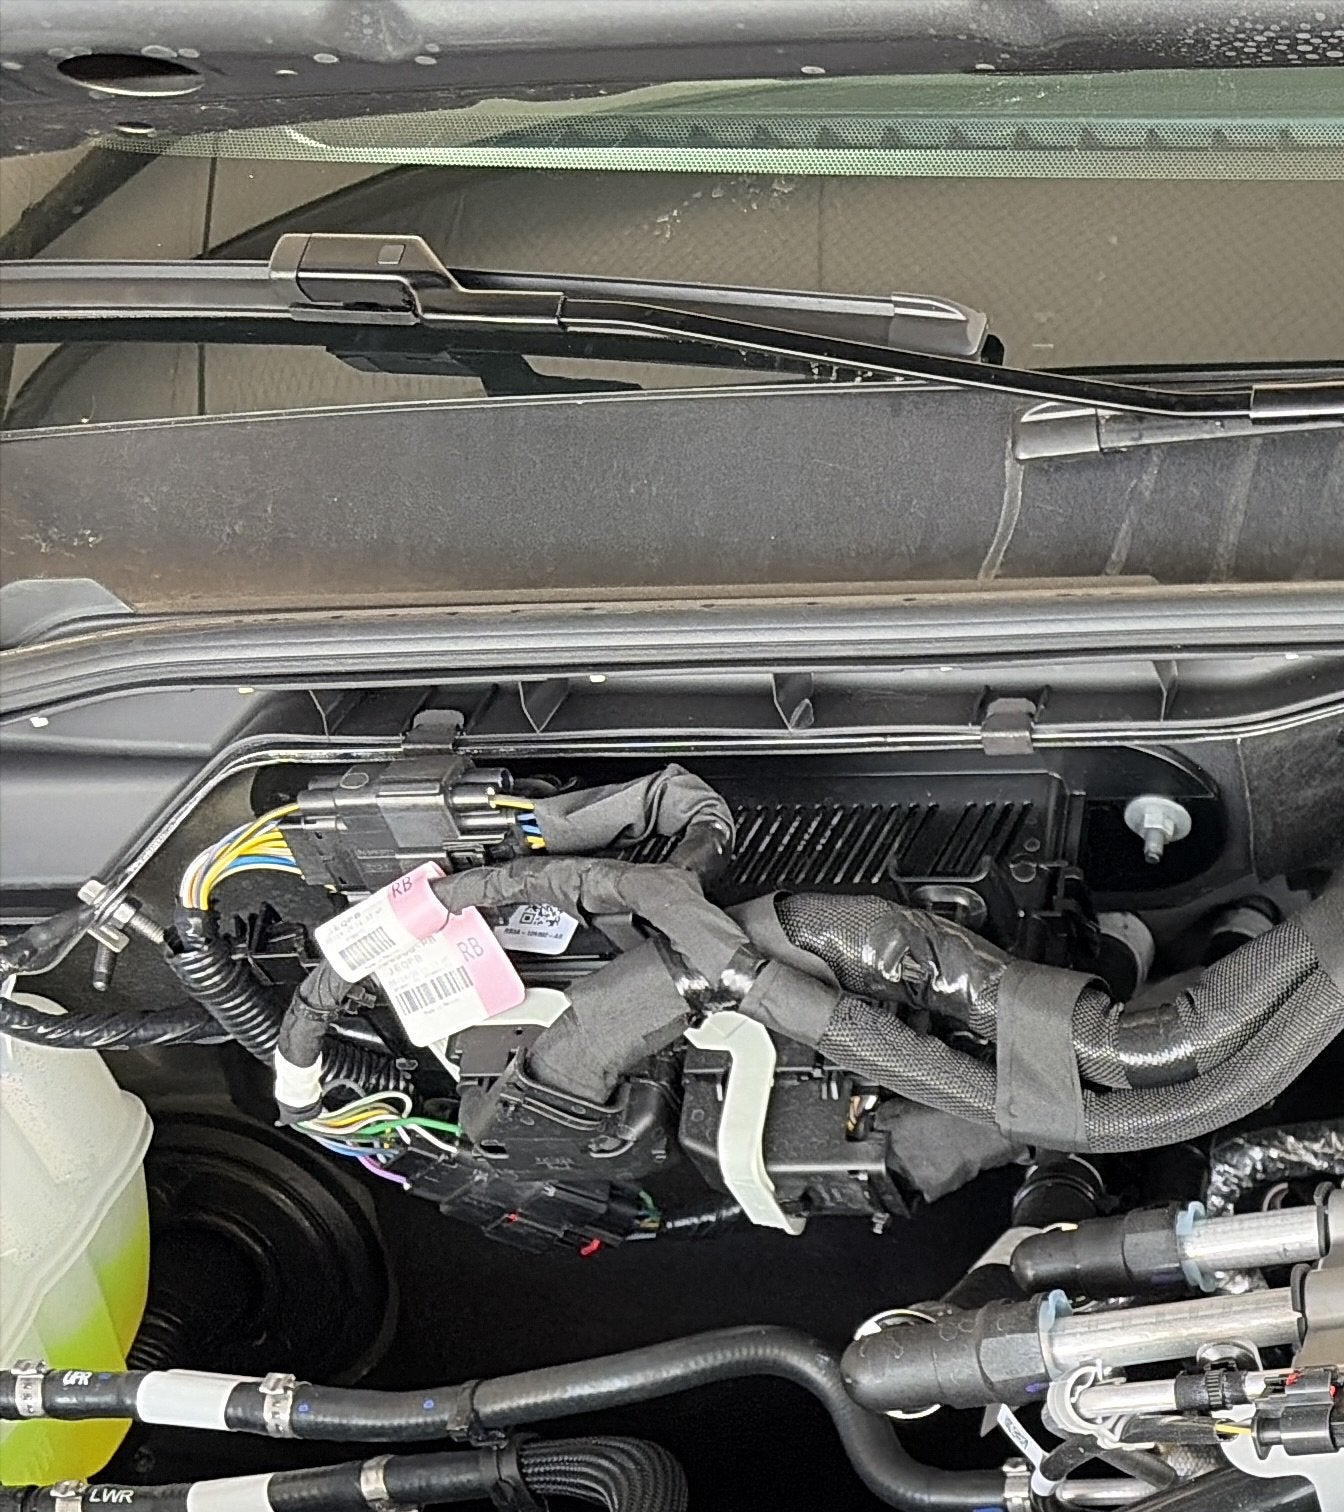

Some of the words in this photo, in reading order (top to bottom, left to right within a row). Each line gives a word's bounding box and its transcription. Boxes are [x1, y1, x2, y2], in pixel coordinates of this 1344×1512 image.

[391, 876, 413, 898] RB
[456, 936, 485, 961] RB
[62, 1370, 92, 1386] UPR
[88, 1488, 135, 1504] LWR
